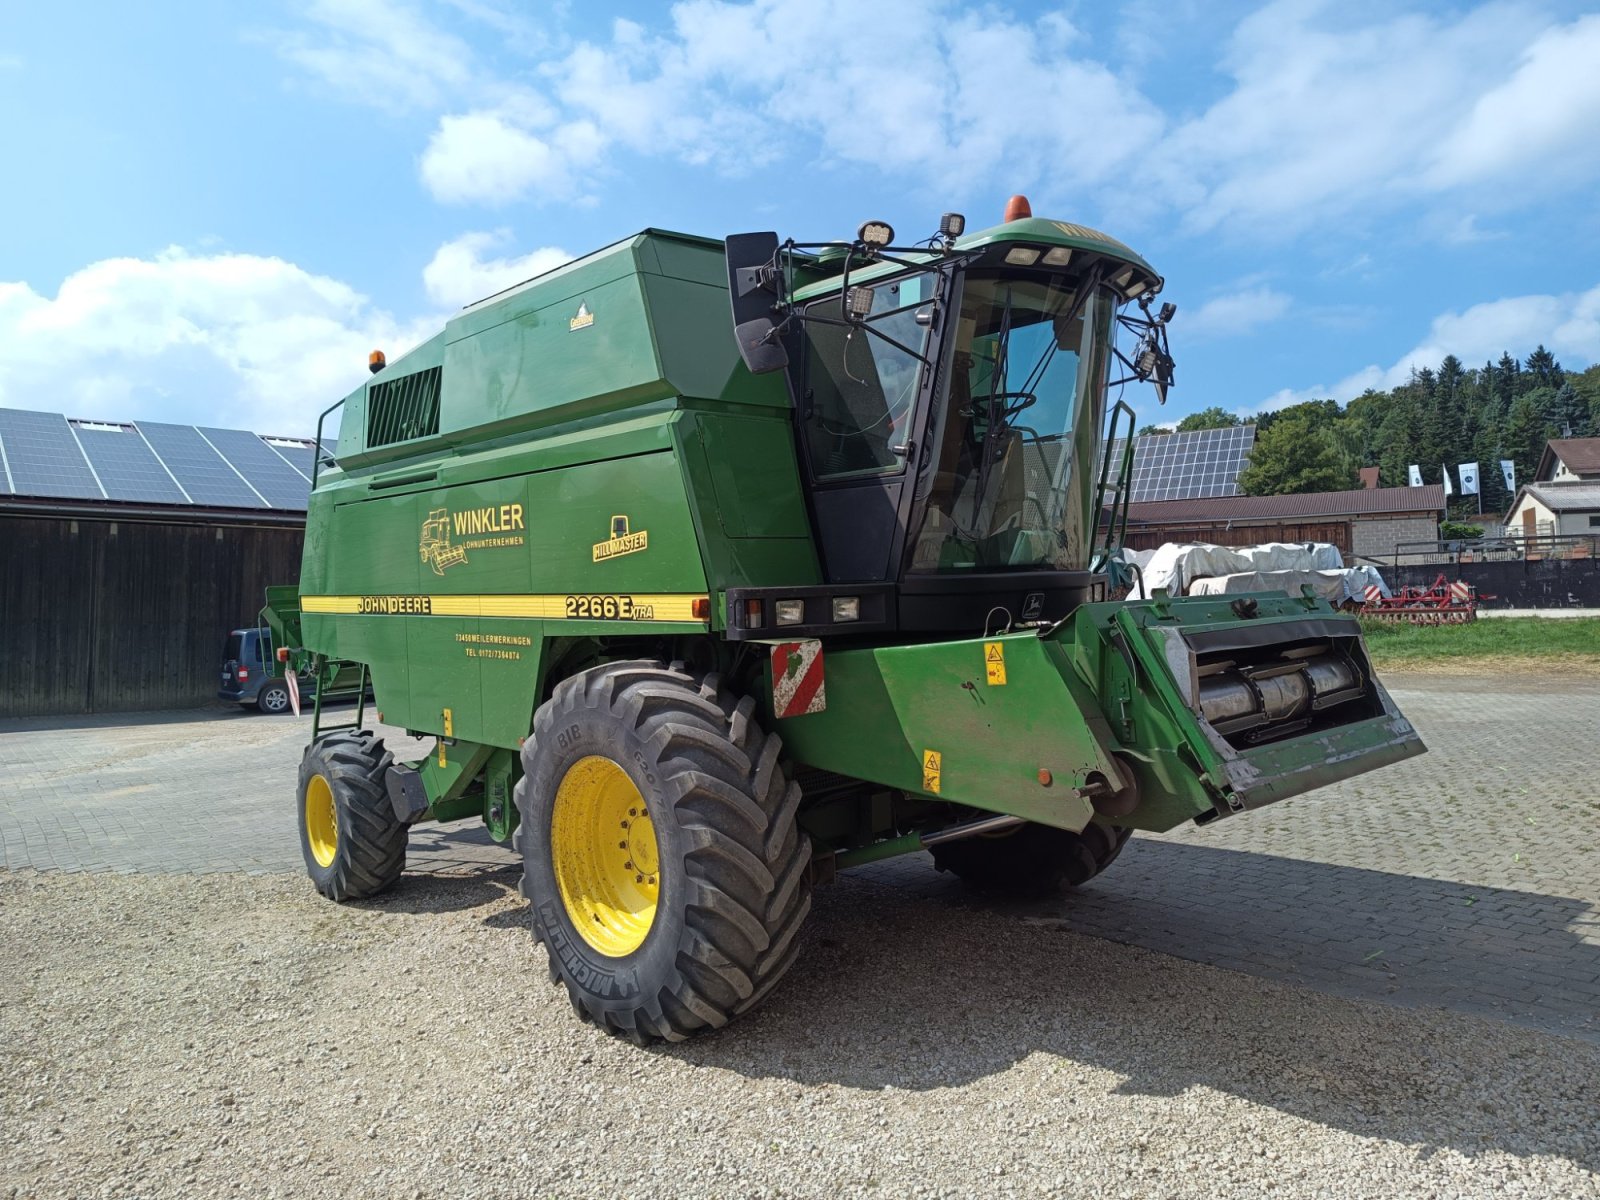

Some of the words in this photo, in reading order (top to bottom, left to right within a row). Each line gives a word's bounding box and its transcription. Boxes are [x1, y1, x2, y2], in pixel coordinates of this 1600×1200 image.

[453, 504, 524, 536] WINKLER
[358, 596, 387, 613] JOHN
[390, 597, 431, 614] DEERE
[566, 596, 617, 618] 2266
[557, 724, 582, 749] BIB
[541, 907, 614, 997] MICHELIN
